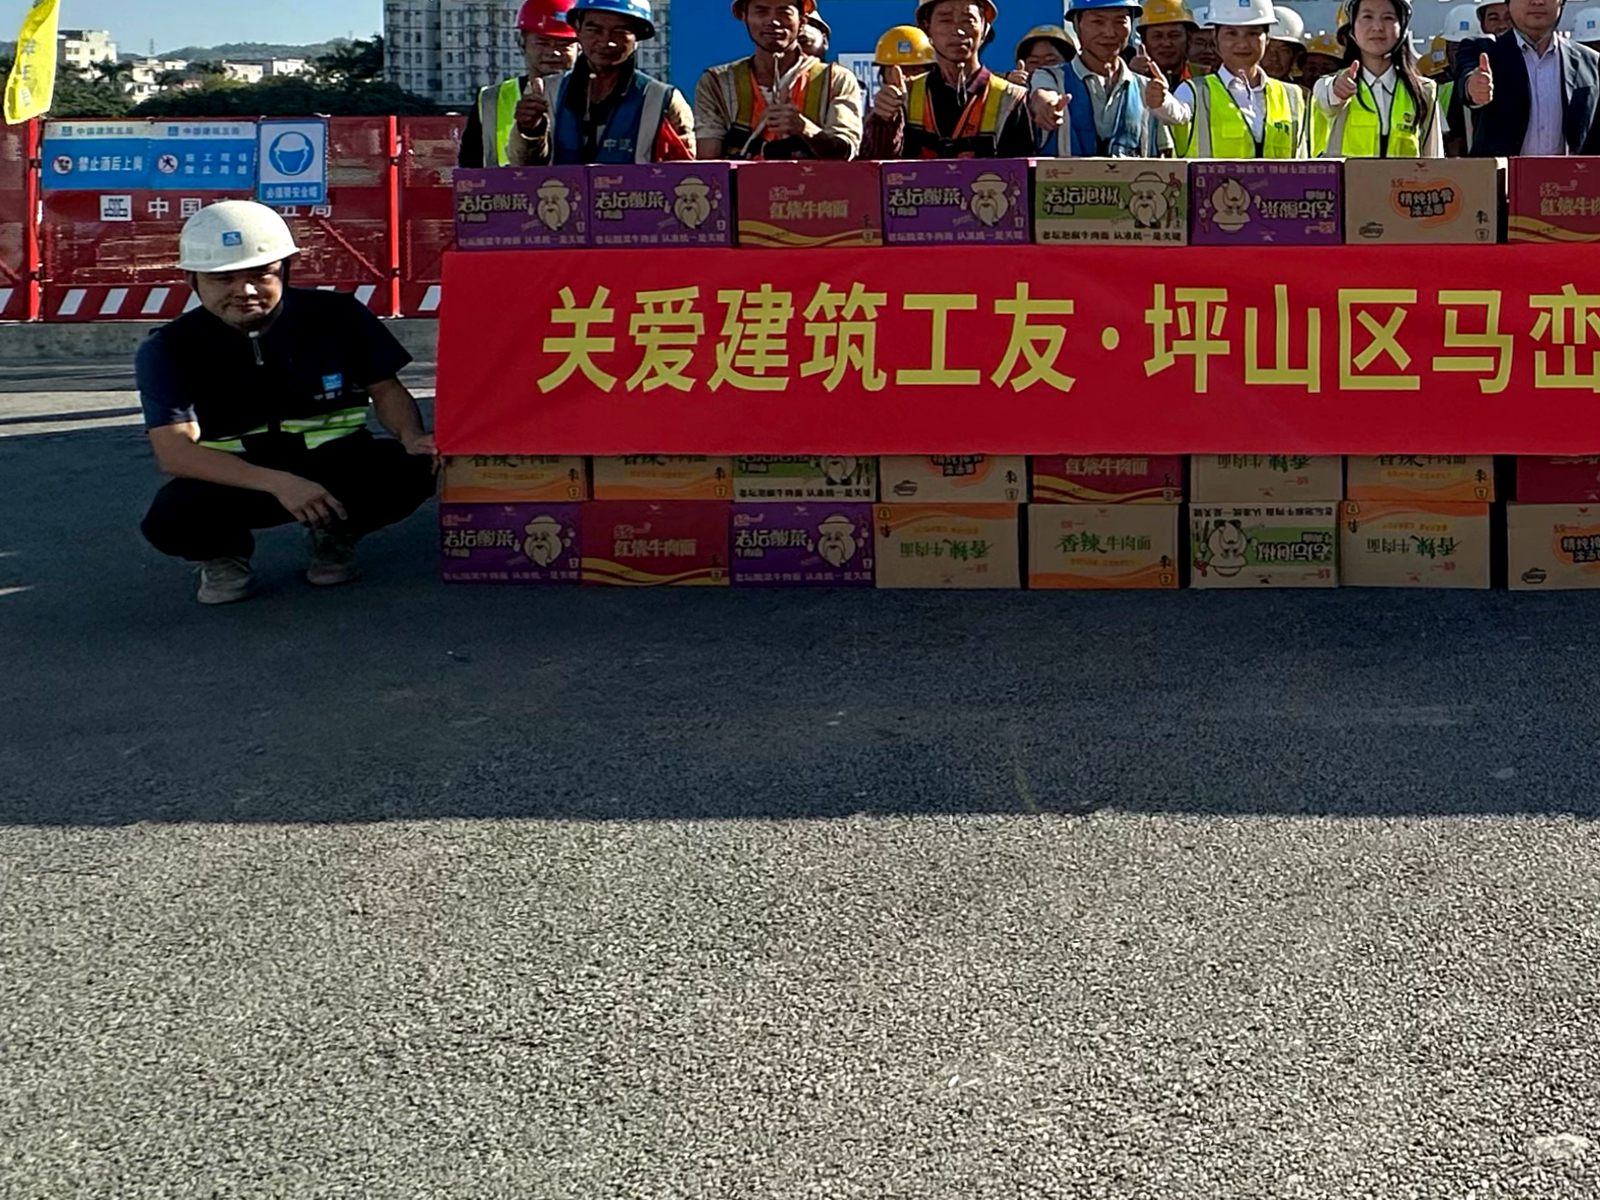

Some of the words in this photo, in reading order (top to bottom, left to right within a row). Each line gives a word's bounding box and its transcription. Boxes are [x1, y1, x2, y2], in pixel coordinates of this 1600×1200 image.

[78, 156, 143, 172] 禁止酒后上岗
[458, 194, 529, 212] 老坛酸菜
[594, 191, 665, 210] 老坛酸菜
[888, 187, 961, 206] 老坛酸菜
[1045, 186, 1120, 206] 老坛泡椒
[147, 196, 333, 219] 中国五局
[1064, 457, 1149, 476] 红烧牛肉面
[1055, 530, 1151, 553] 香辣牛肉面
